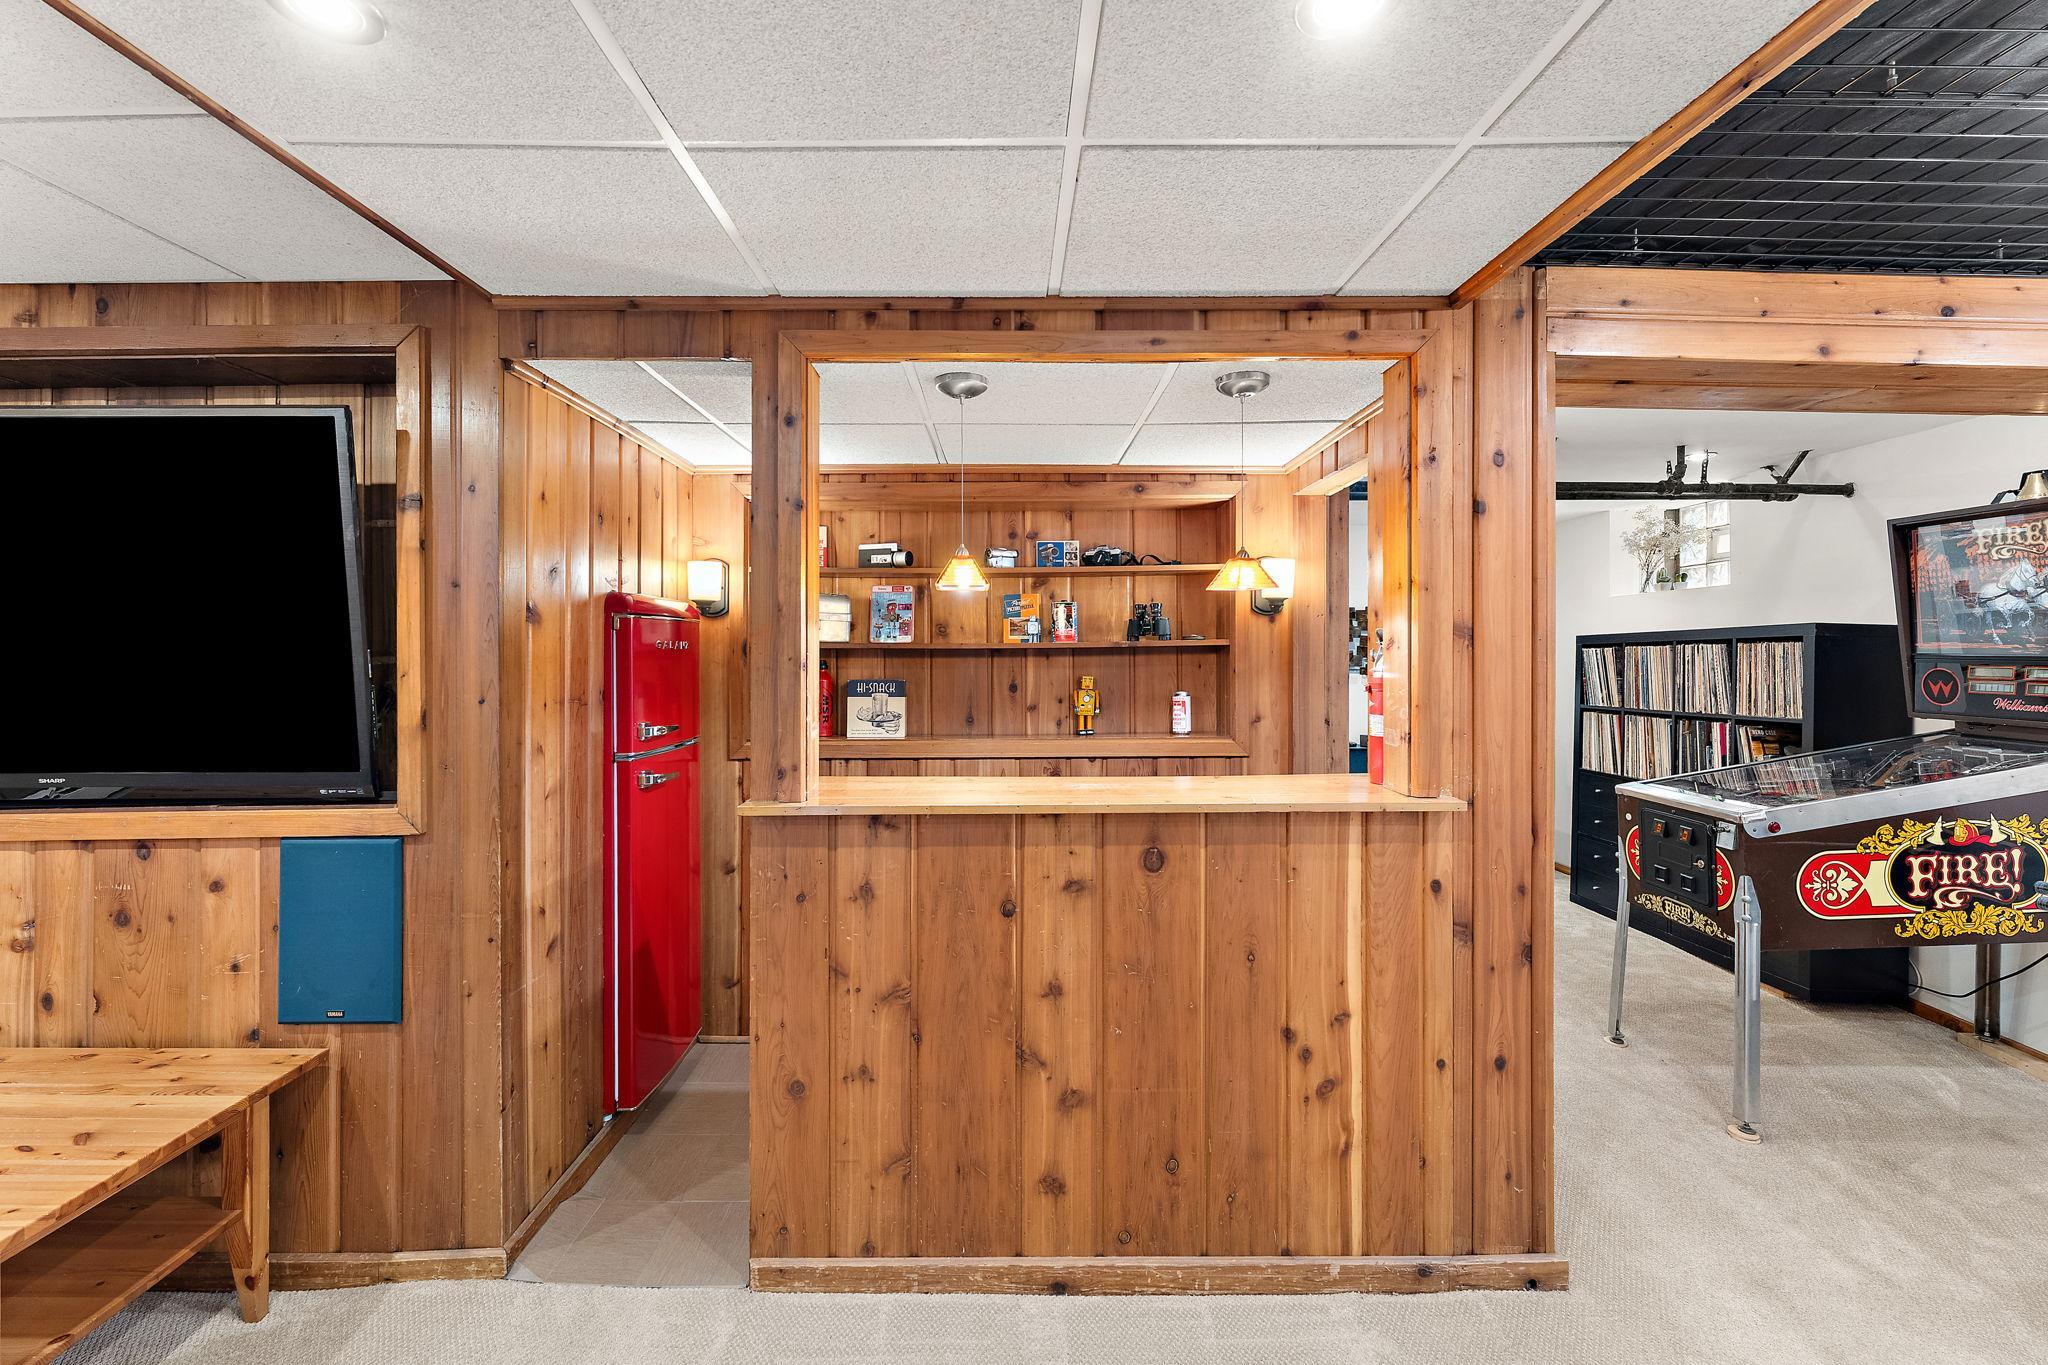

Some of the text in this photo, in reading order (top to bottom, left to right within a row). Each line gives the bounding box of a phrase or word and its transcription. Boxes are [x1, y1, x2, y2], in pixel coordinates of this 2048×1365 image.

[856, 682, 896, 693] HI-SNACK
[822, 694, 830, 724] MSR
[1905, 848, 2022, 906] FIRE!
[1663, 900, 1691, 920] FIRE!
